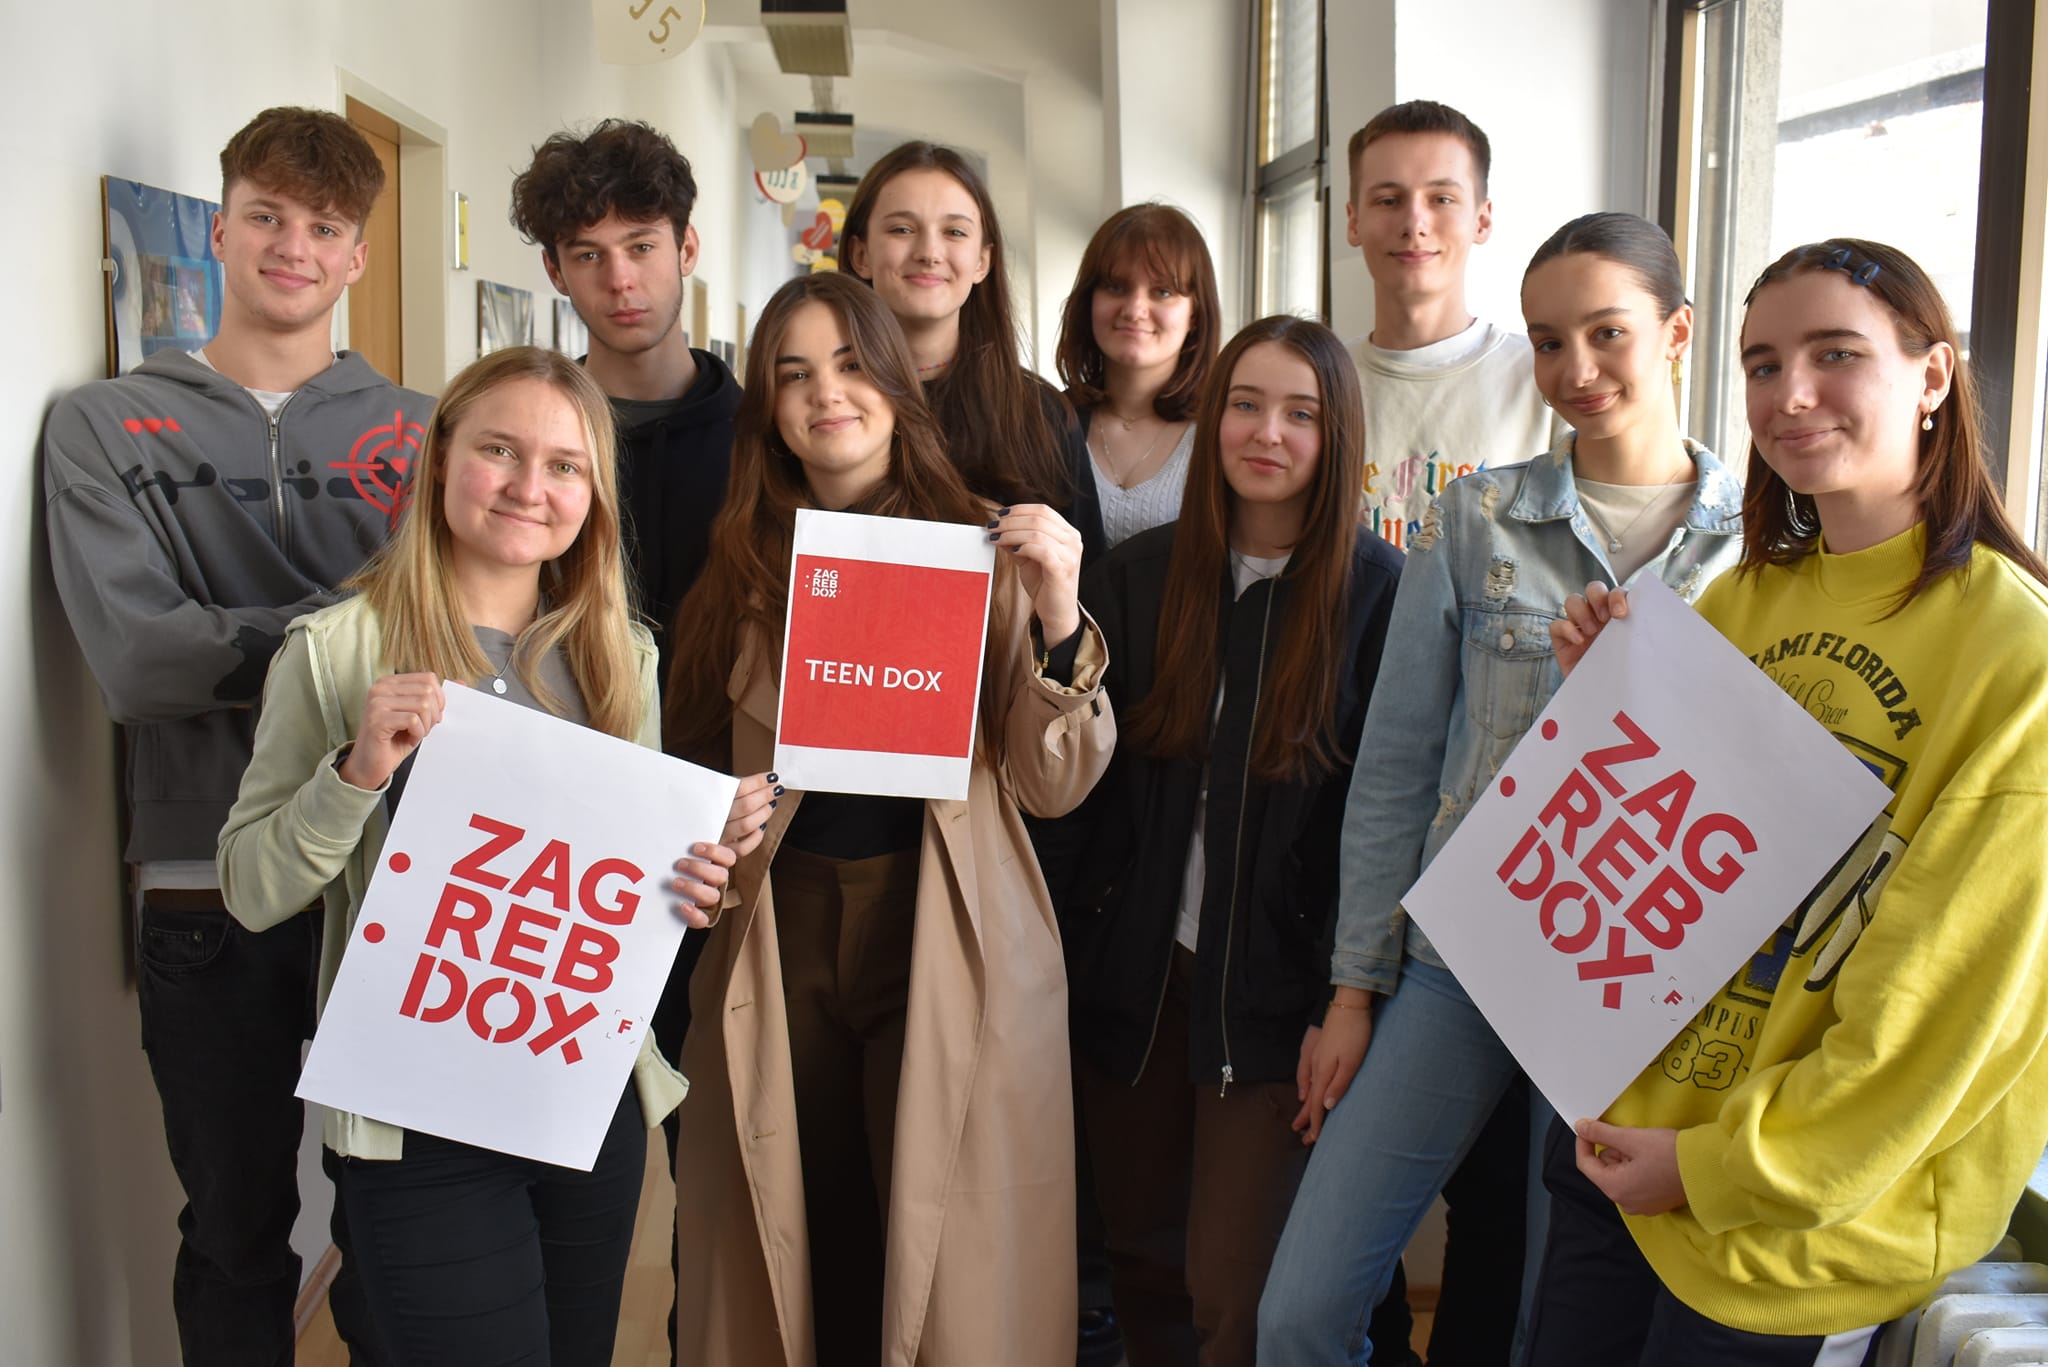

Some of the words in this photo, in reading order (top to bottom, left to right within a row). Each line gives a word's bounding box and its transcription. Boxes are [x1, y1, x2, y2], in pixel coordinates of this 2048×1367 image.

[811, 588, 837, 598] DOX
[812, 578, 838, 589] REB
[813, 568, 839, 579] ZAG
[805, 659, 875, 686] TEEN
[883, 667, 943, 692] DOX
[1812, 632, 1922, 741] FLORIDA
[1581, 711, 1758, 894] ZAG
[450, 813, 645, 926] ZAG
[1538, 768, 1703, 950] REB
[425, 882, 621, 993] REB
[1496, 825, 1655, 1010] DOX
[399, 952, 600, 1065] DOX
[1694, 1001, 1759, 1041] MPUS
